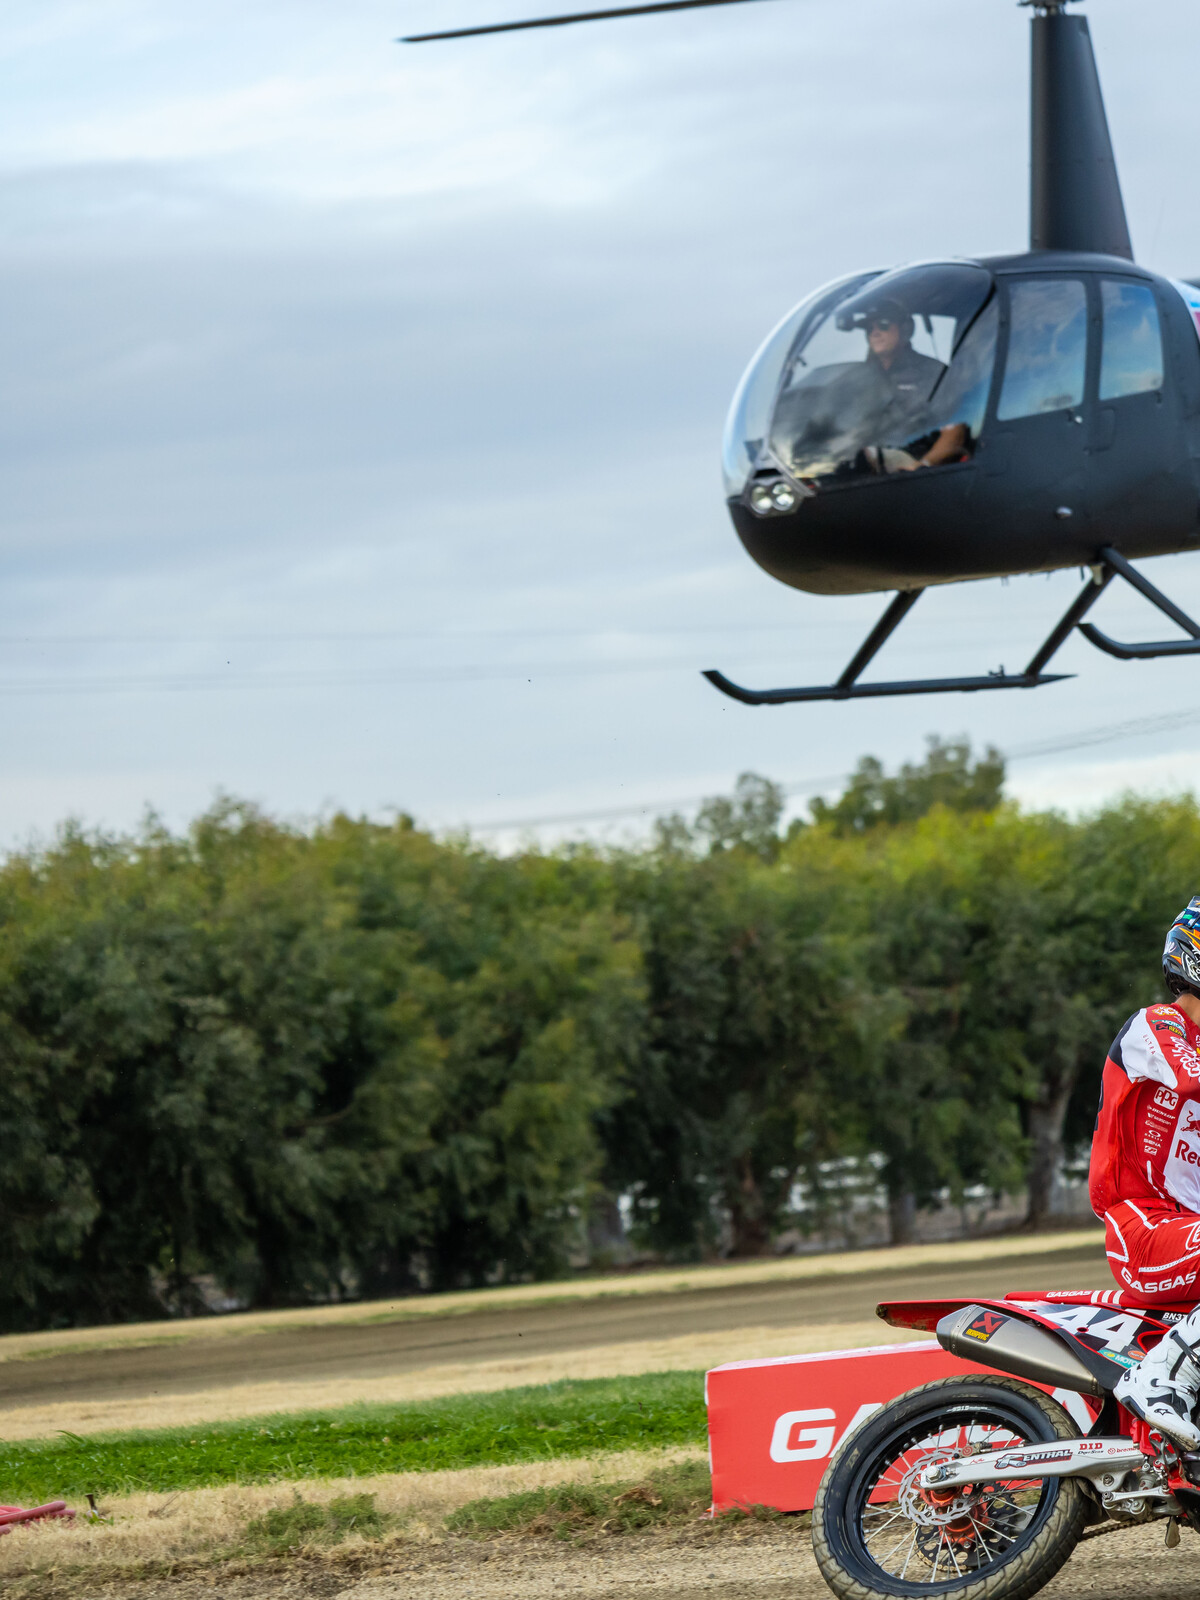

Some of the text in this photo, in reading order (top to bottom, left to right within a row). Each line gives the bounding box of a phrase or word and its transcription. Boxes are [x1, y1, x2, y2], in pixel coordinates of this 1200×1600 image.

[1156, 1089, 1178, 1107] PPG
[1121, 1267, 1197, 1293] GASGAS
[1046, 1290, 1092, 1298] GASGAS
[1115, 1355, 1138, 1368] MOTO
[1079, 1442, 1103, 1451] DID
[995, 1449, 1073, 1470] RENTHAL
